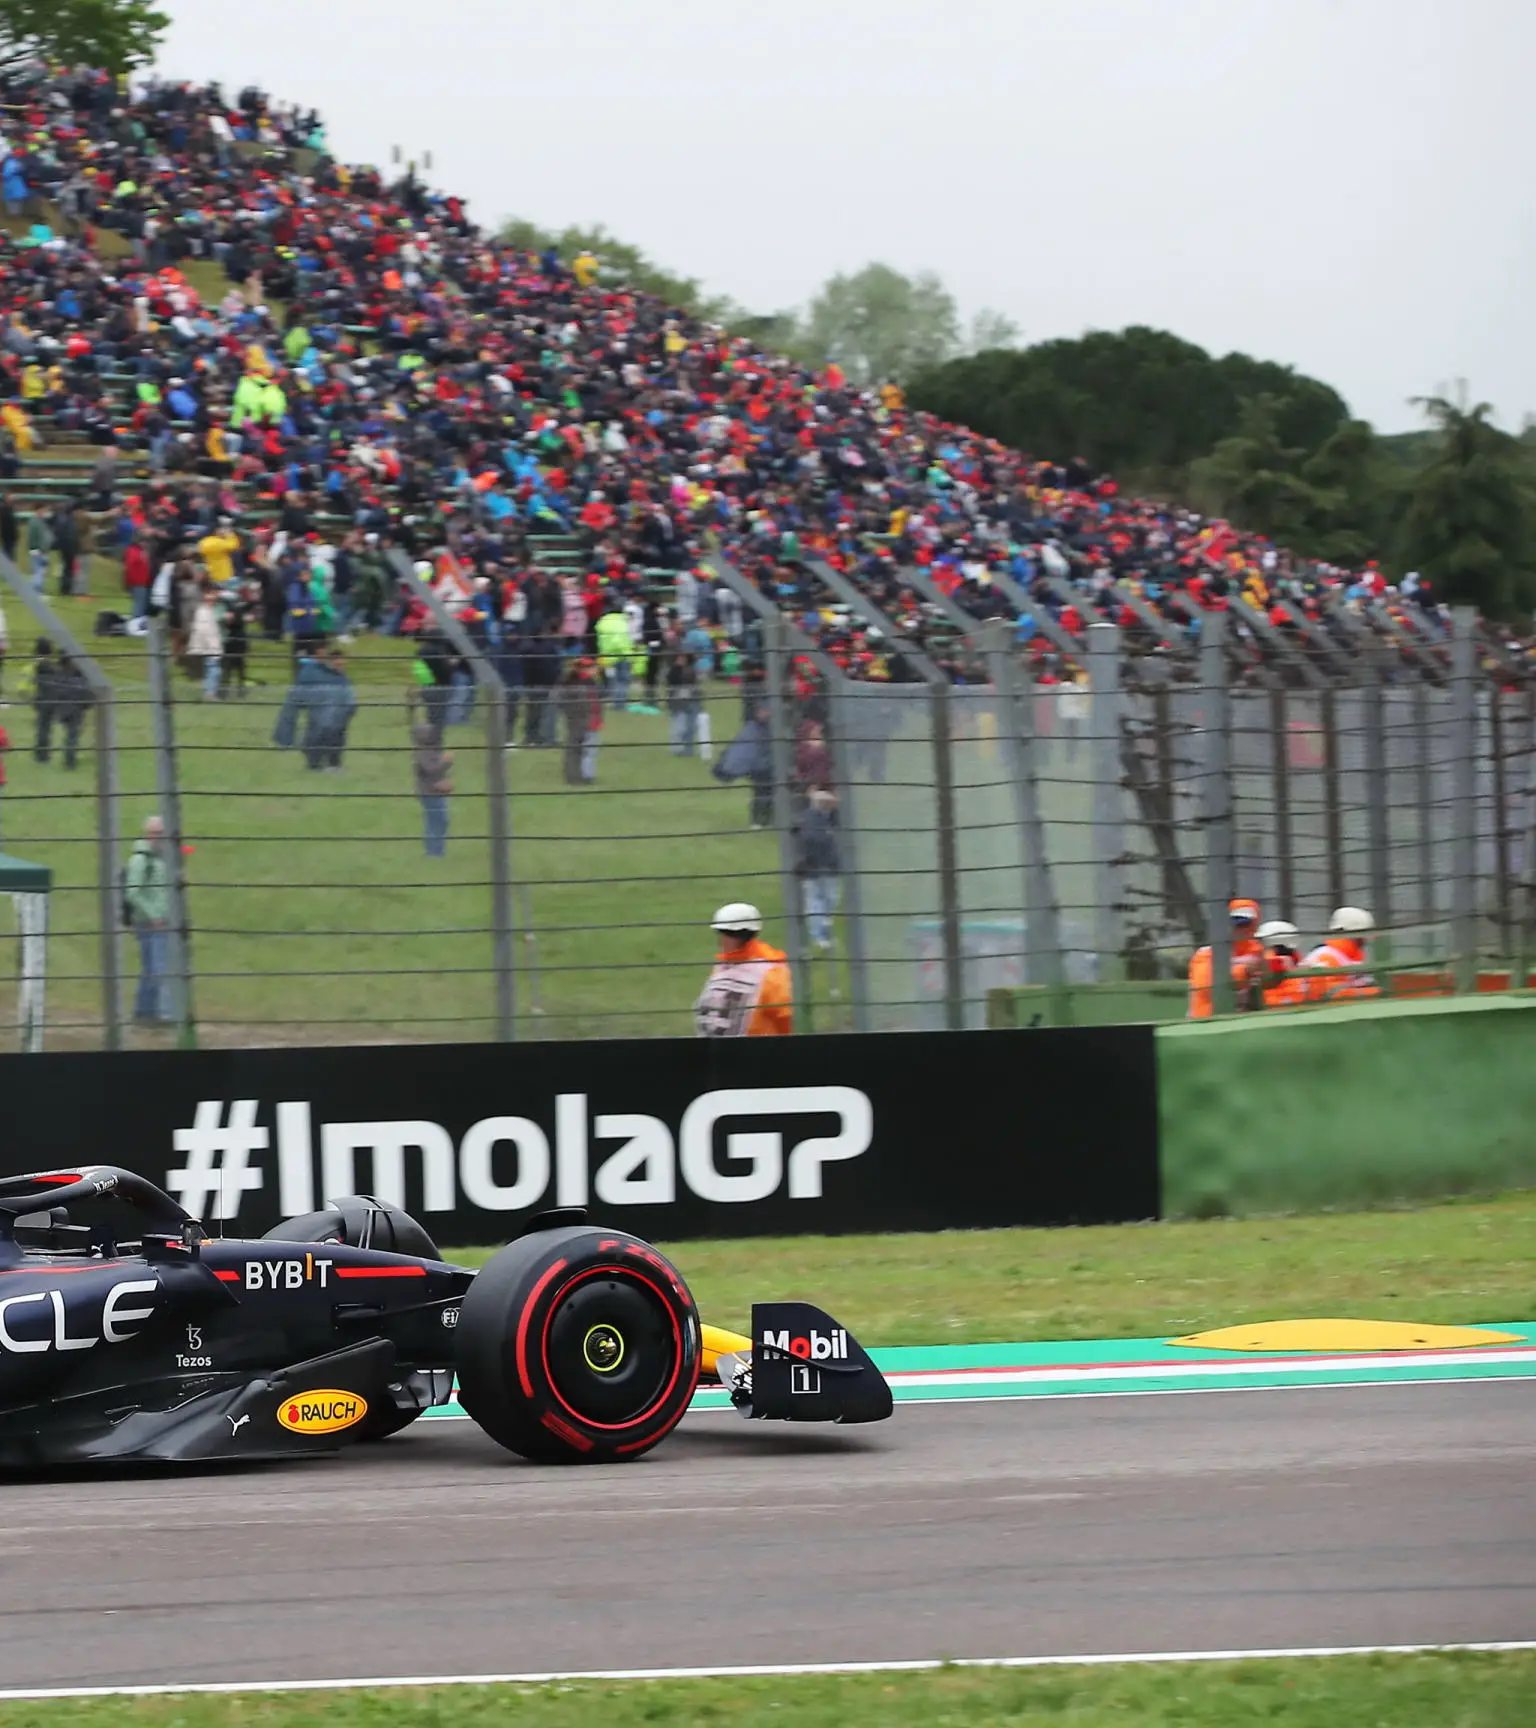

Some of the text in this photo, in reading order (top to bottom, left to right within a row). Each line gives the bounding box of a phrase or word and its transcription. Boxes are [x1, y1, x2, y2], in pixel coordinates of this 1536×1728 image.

[166, 1085, 873, 1218] #ImolaGP
[245, 1252, 333, 1290] BYBIT
[764, 1329, 848, 1360] Mobil
[175, 1354, 212, 1367] Tezos
[301, 1402, 356, 1422] RAUCH
